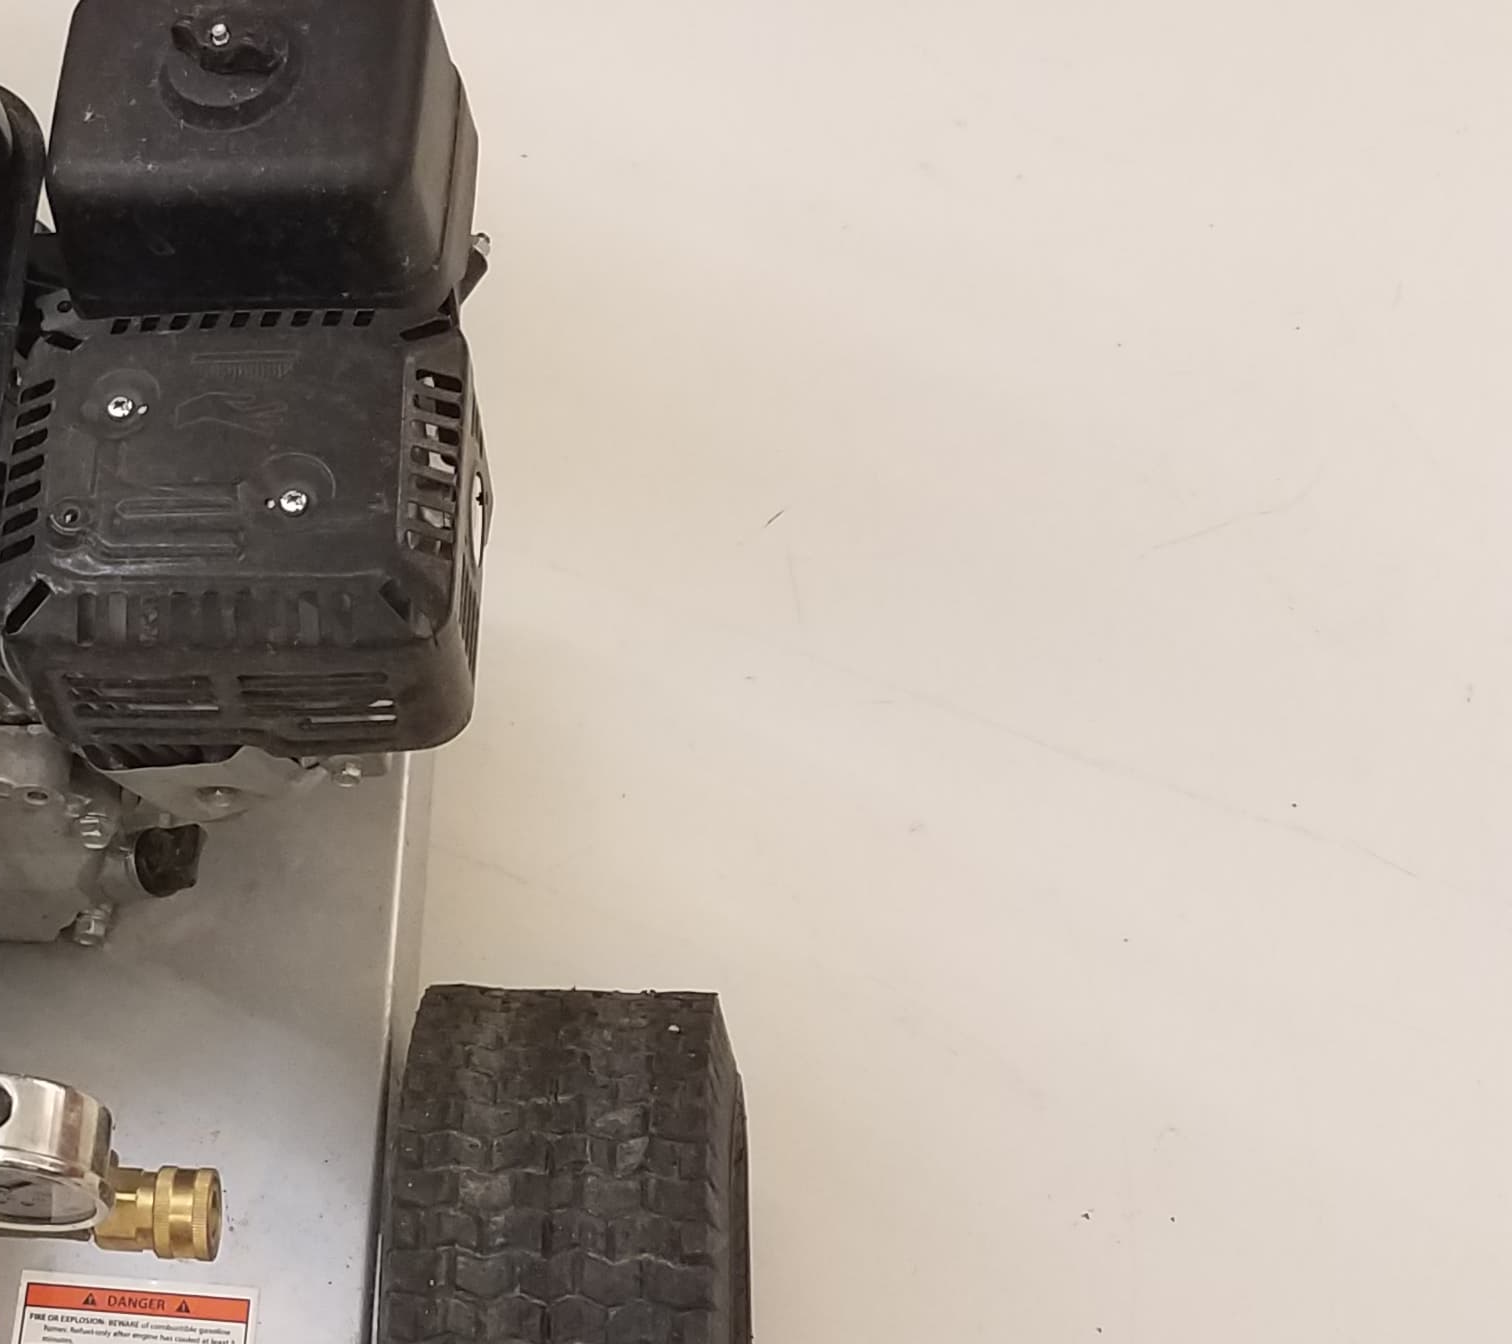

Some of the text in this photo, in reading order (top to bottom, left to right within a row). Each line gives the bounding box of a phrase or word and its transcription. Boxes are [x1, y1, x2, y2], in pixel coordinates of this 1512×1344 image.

[107, 1295, 165, 1311] DANGER
[30, 1312, 46, 1321] FIRE
[47, 1314, 59, 1322] OR
